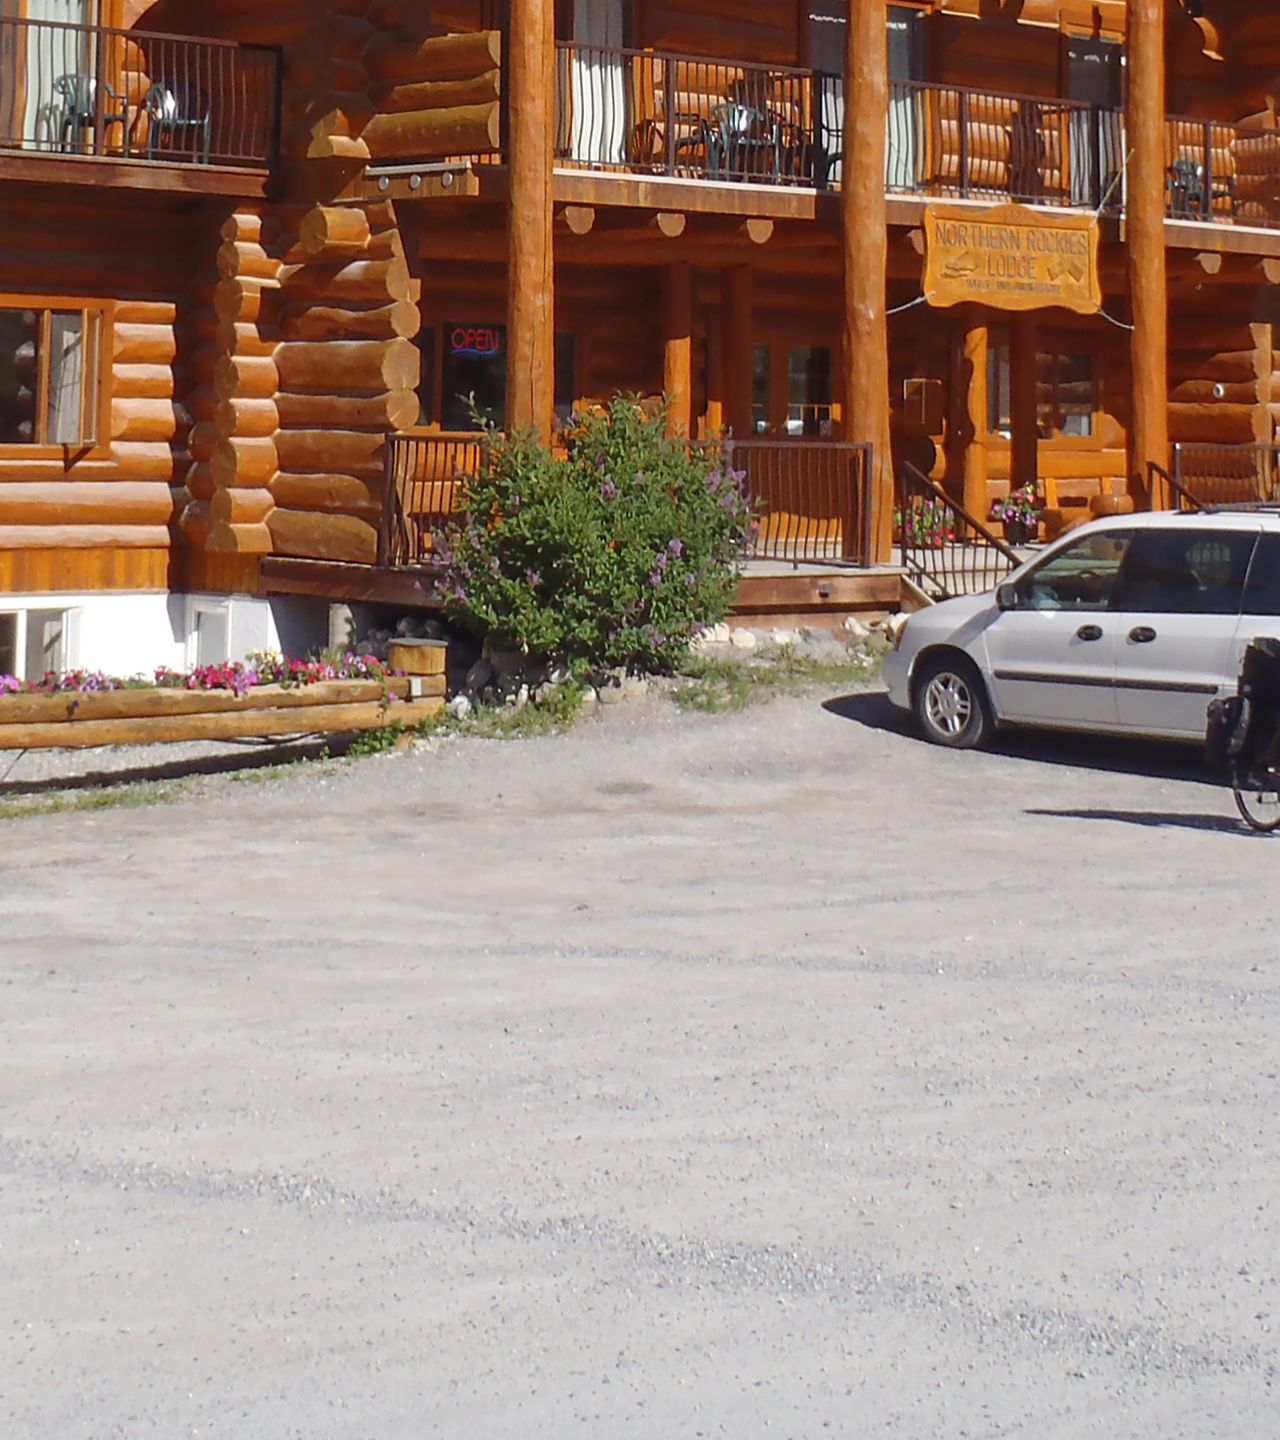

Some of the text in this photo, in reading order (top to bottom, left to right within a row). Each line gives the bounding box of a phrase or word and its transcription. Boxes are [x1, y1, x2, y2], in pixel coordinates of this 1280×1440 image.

[934, 222, 1088, 256] NORTHERN ROCKIES
[987, 254, 1038, 280] LODGE
[451, 327, 500, 350] OPEN
